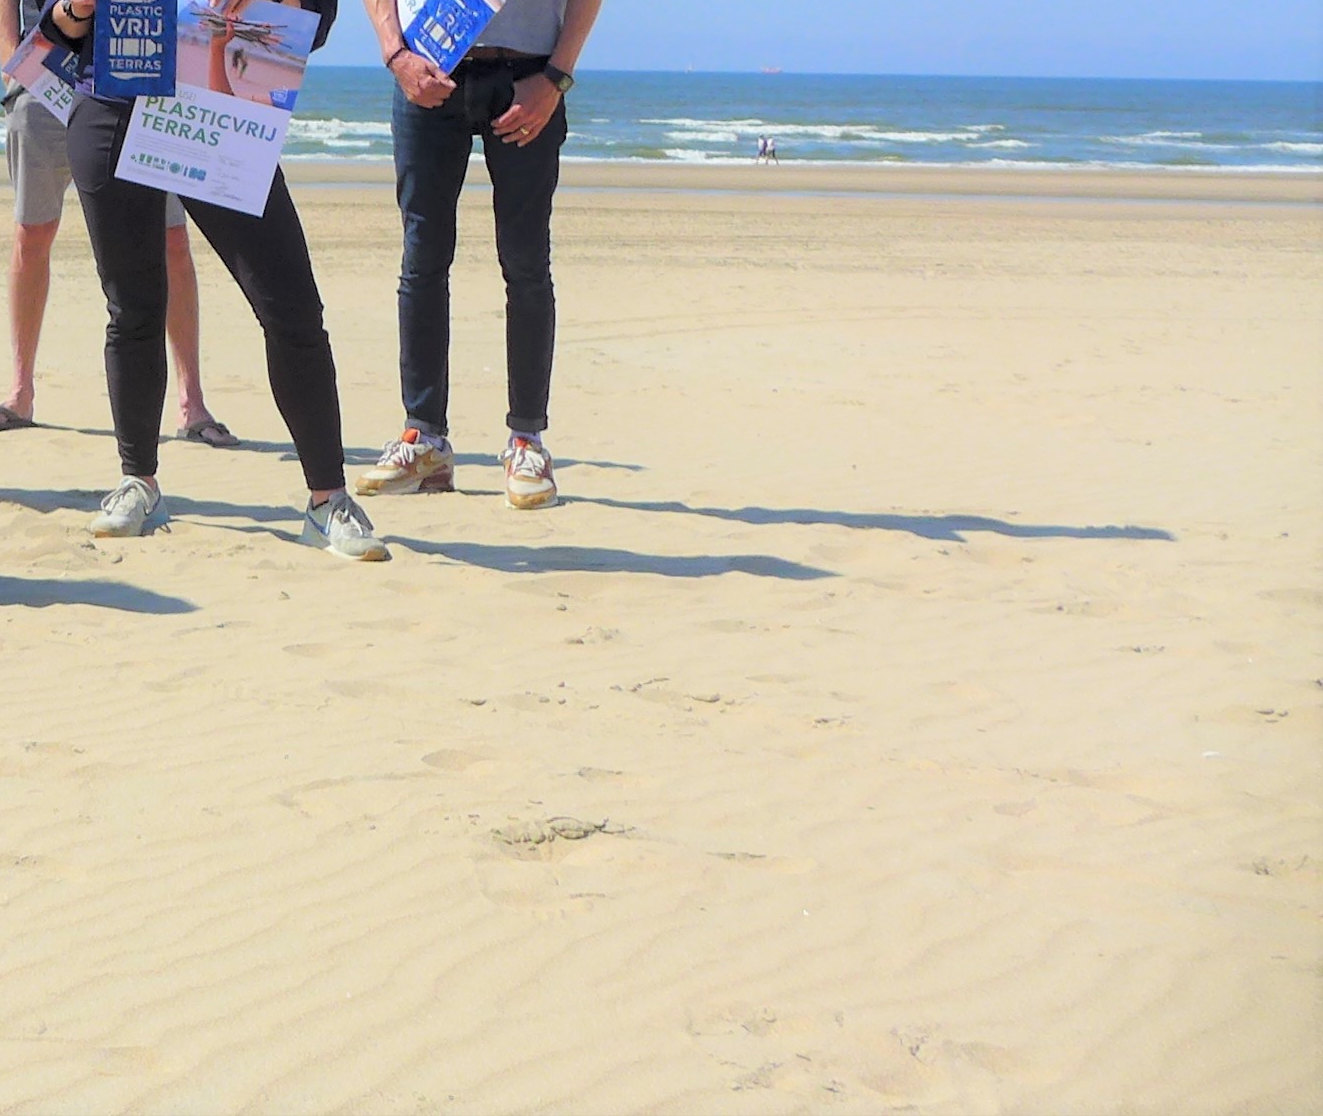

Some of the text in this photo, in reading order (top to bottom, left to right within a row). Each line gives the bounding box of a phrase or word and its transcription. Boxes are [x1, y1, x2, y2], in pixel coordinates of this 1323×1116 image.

[109, 4, 163, 17] PLASTIC
[110, 17, 163, 37] VRIJ
[109, 58, 162, 71] TERRAS
[141, 112, 221, 146] TERRAS
[145, 96, 277, 142] PLASTICVRIJ
